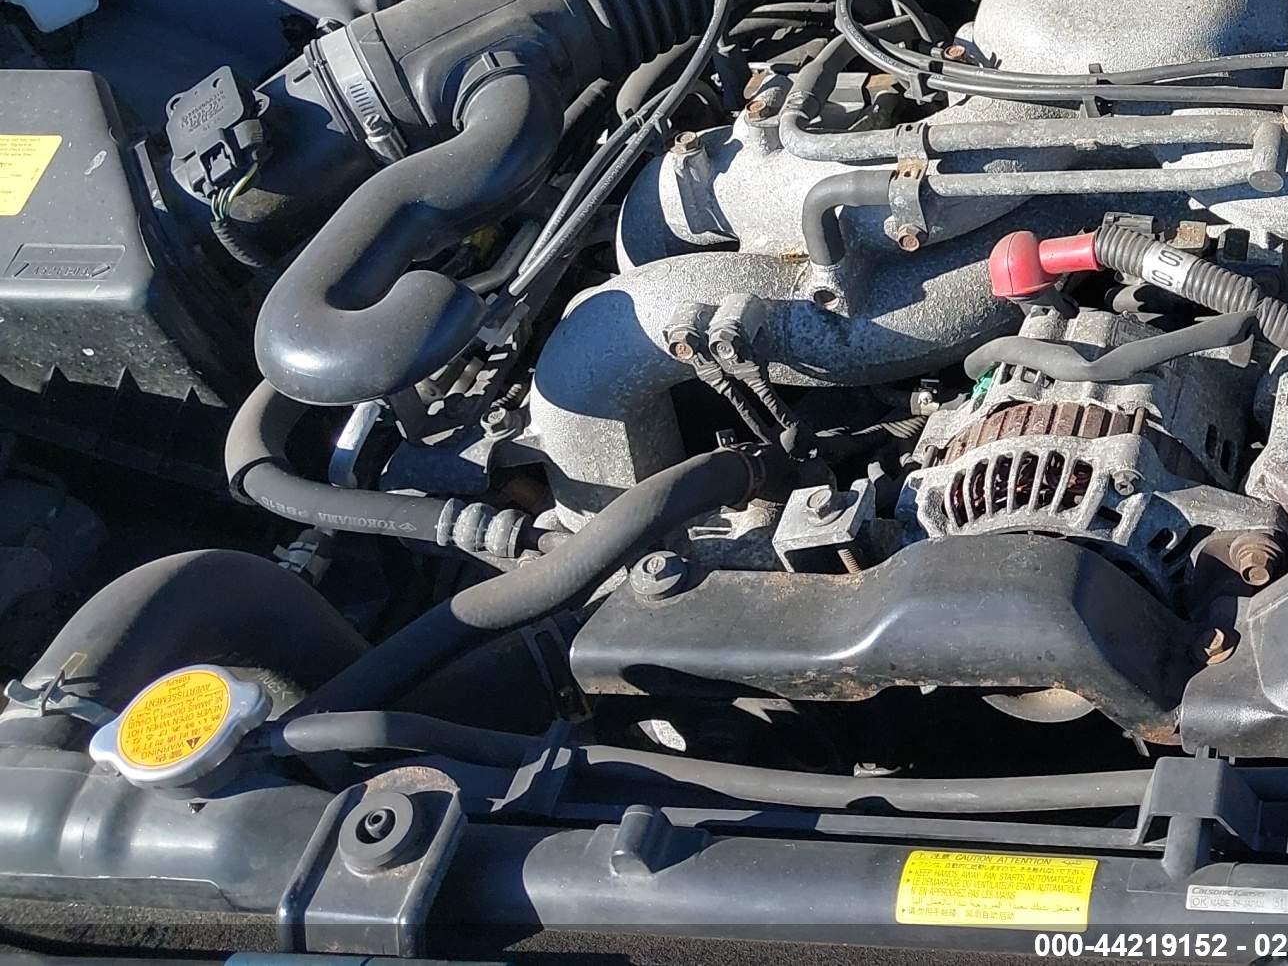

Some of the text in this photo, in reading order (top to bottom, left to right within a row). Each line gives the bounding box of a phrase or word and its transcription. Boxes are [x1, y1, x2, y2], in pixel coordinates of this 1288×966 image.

[317, 512, 397, 531] YOKOHAMA
[198, 703, 223, 715] NEVER
[128, 728, 144, 738] HOT
[954, 853, 994, 863] CAUTION
[996, 854, 1053, 865] ATTENTION
[983, 872, 997, 880] FAN
[999, 873, 1025, 882] STARTS
[1027, 873, 1085, 884] AUTOMATICALLY
[1192, 898, 1208, 908] OK
